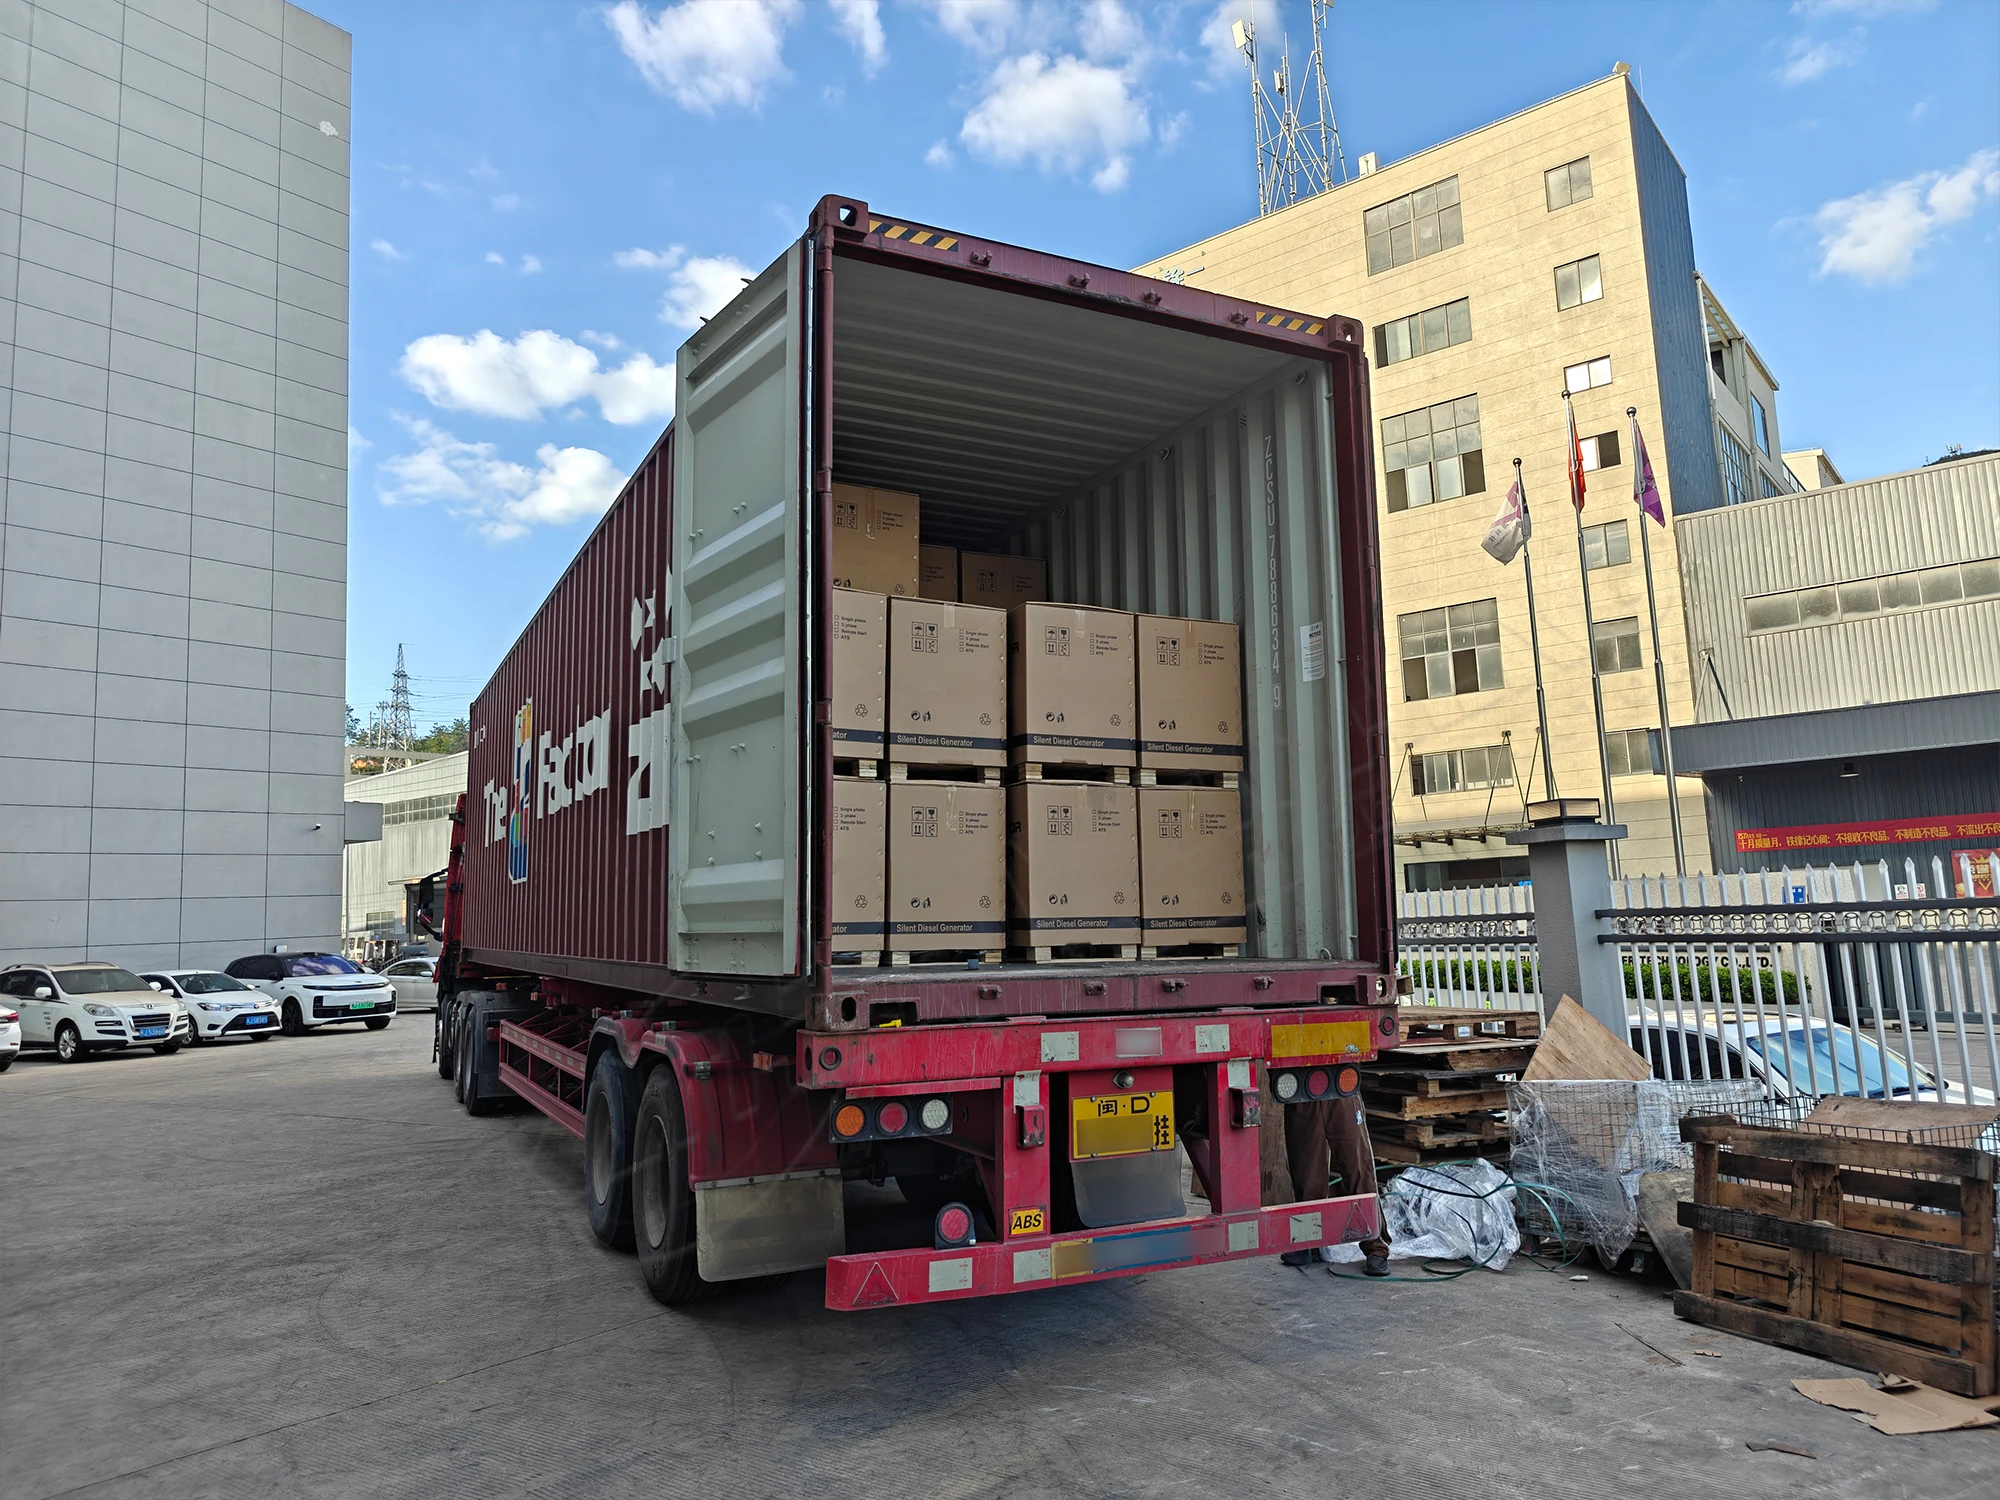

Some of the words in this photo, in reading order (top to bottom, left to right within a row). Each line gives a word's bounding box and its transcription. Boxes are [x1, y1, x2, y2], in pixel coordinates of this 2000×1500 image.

[1264, 435, 1275, 526] ZCSU
[1268, 535, 1281, 674] 788634
[897, 735, 917, 744] Silent
[918, 736, 939, 745] Diesel
[940, 738, 973, 747] Generator
[1033, 736, 1052, 744] Silent
[1053, 737, 1072, 746] Diesel
[1073, 738, 1104, 747] Generator
[1147, 743, 1164, 751] Silent
[1165, 744, 1184, 752] Diesel
[1185, 745, 1213, 753] Generator
[896, 924, 916, 932] Silent
[918, 924, 938, 932] Diesel
[940, 923, 973, 932] Generator
[1036, 920, 1055, 928] Silent
[1057, 919, 1076, 928] Diesel
[1077, 919, 1108, 927] Generator
[1150, 920, 1167, 928] Silent
[1169, 919, 1187, 928] Diesel
[1188, 919, 1217, 927] Generator
[1154, 1115, 1170, 1146] 挂
[1012, 1213, 1042, 1230] ABS
